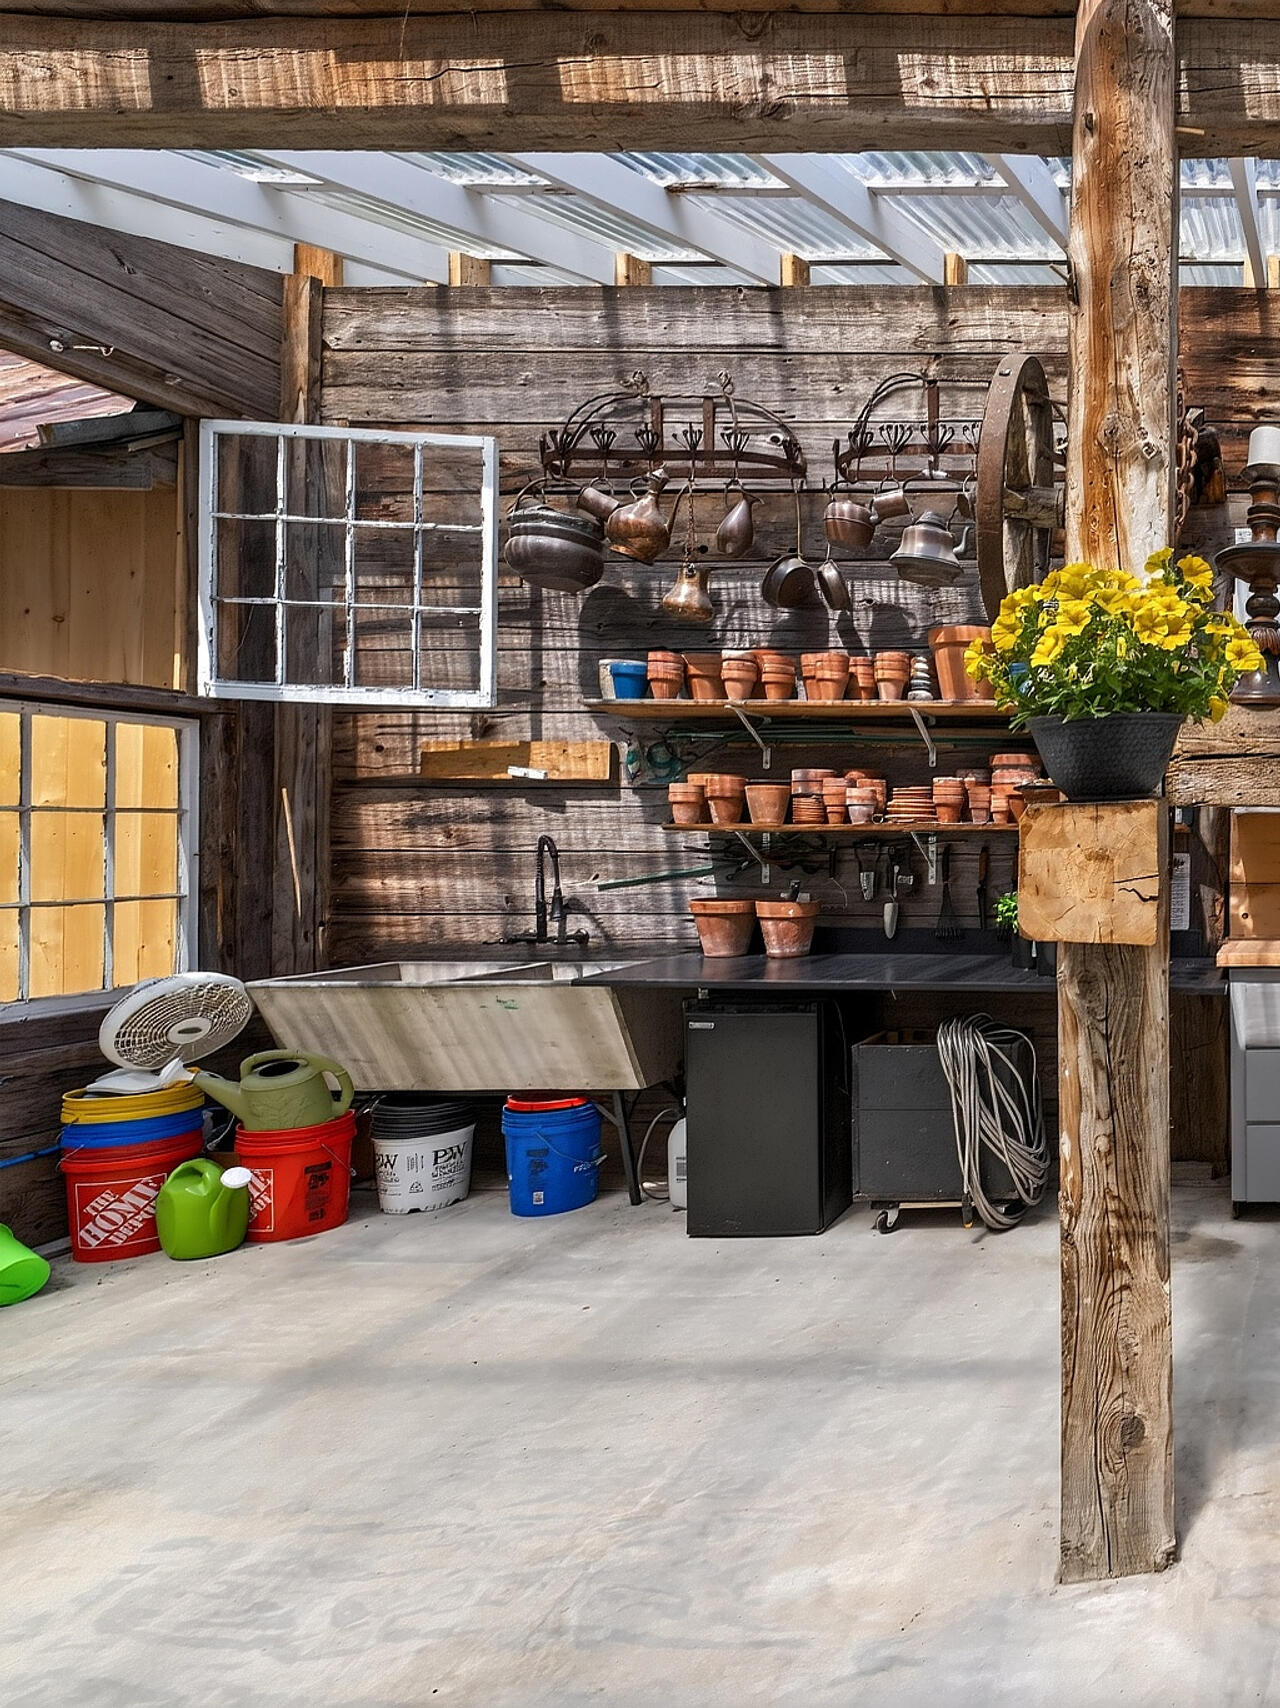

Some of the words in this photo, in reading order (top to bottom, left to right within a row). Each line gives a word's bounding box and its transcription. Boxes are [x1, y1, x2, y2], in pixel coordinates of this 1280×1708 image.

[80, 1178, 163, 1247] HOME
[83, 1189, 119, 1216] THE
[108, 1201, 158, 1245] DEPO
